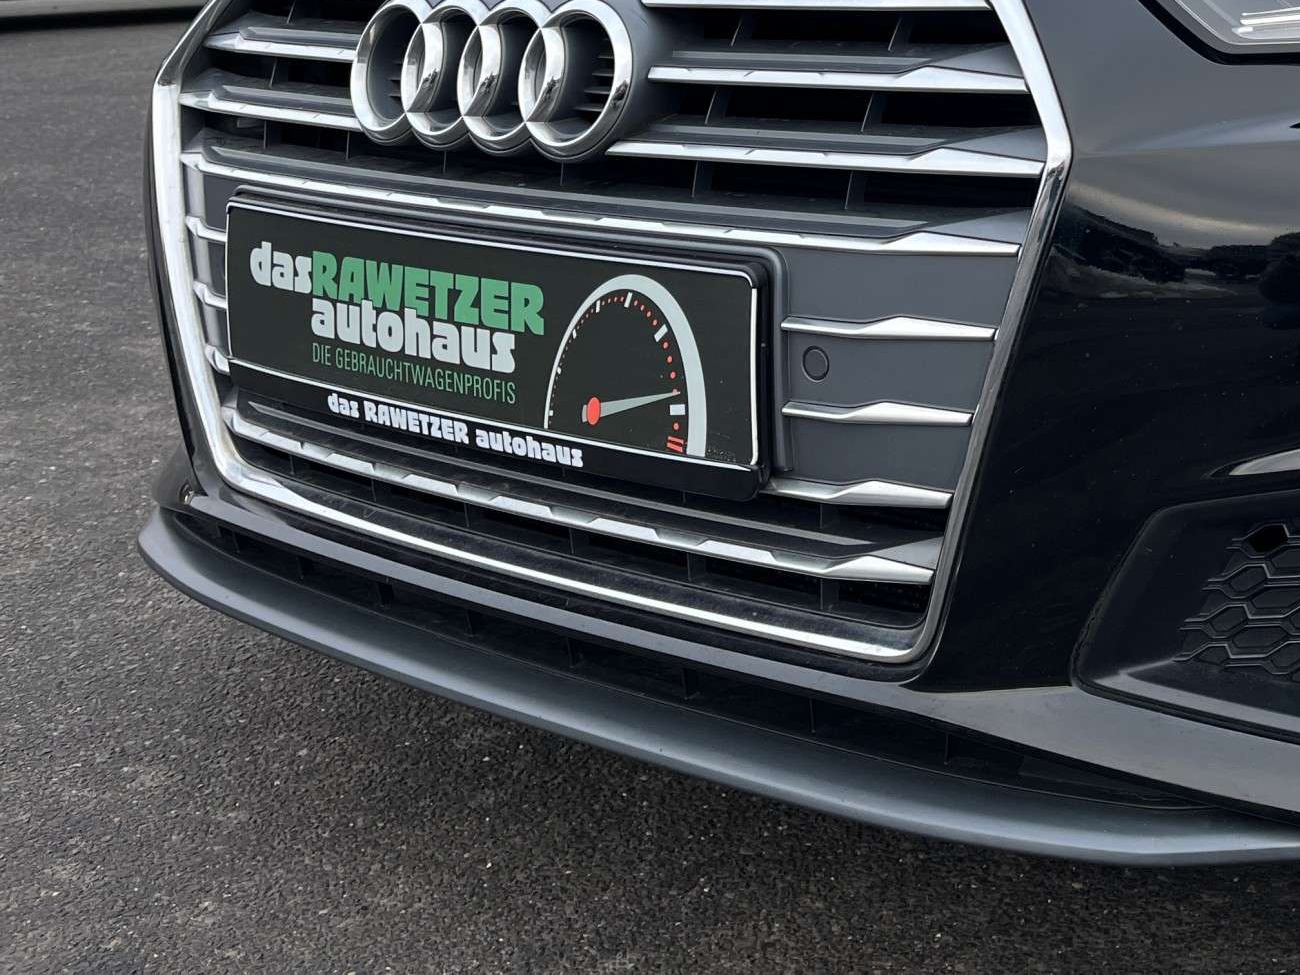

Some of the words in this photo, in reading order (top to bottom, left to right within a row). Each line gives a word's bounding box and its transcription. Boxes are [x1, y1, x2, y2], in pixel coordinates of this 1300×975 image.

[311, 298, 516, 373] autohaus
[312, 343, 332, 366] DIE
[336, 348, 516, 404] GEBRAUCHTWAGENPROFIS
[327, 393, 360, 418] das
[364, 400, 470, 444] RAWETZER
[475, 428, 584, 467] autohaus
